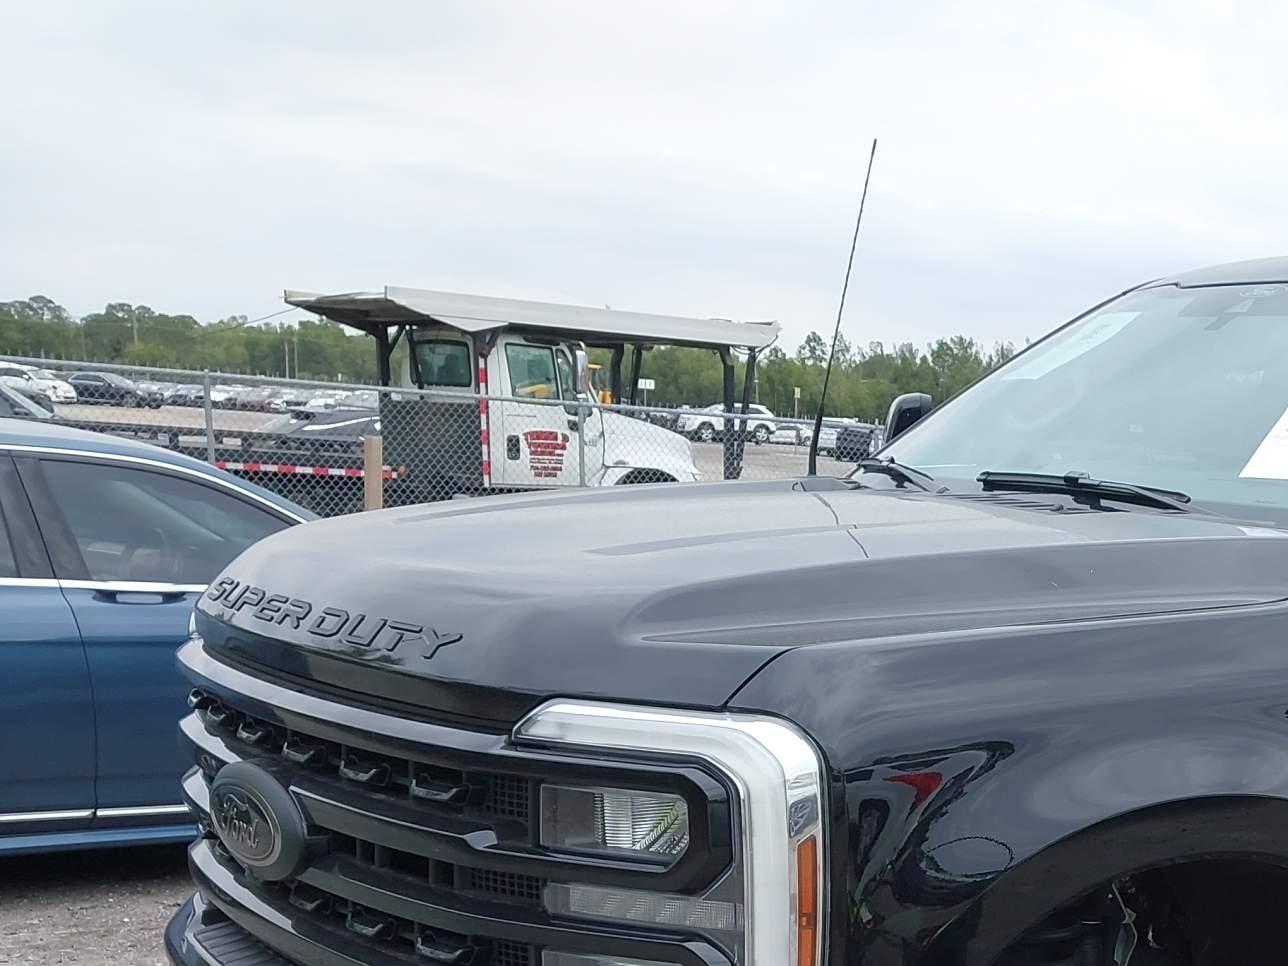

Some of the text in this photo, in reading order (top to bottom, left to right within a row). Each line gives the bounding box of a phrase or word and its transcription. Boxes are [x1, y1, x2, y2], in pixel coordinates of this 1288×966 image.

[207, 577, 464, 660] SUPER DUTY
[218, 793, 260, 849] Ford
